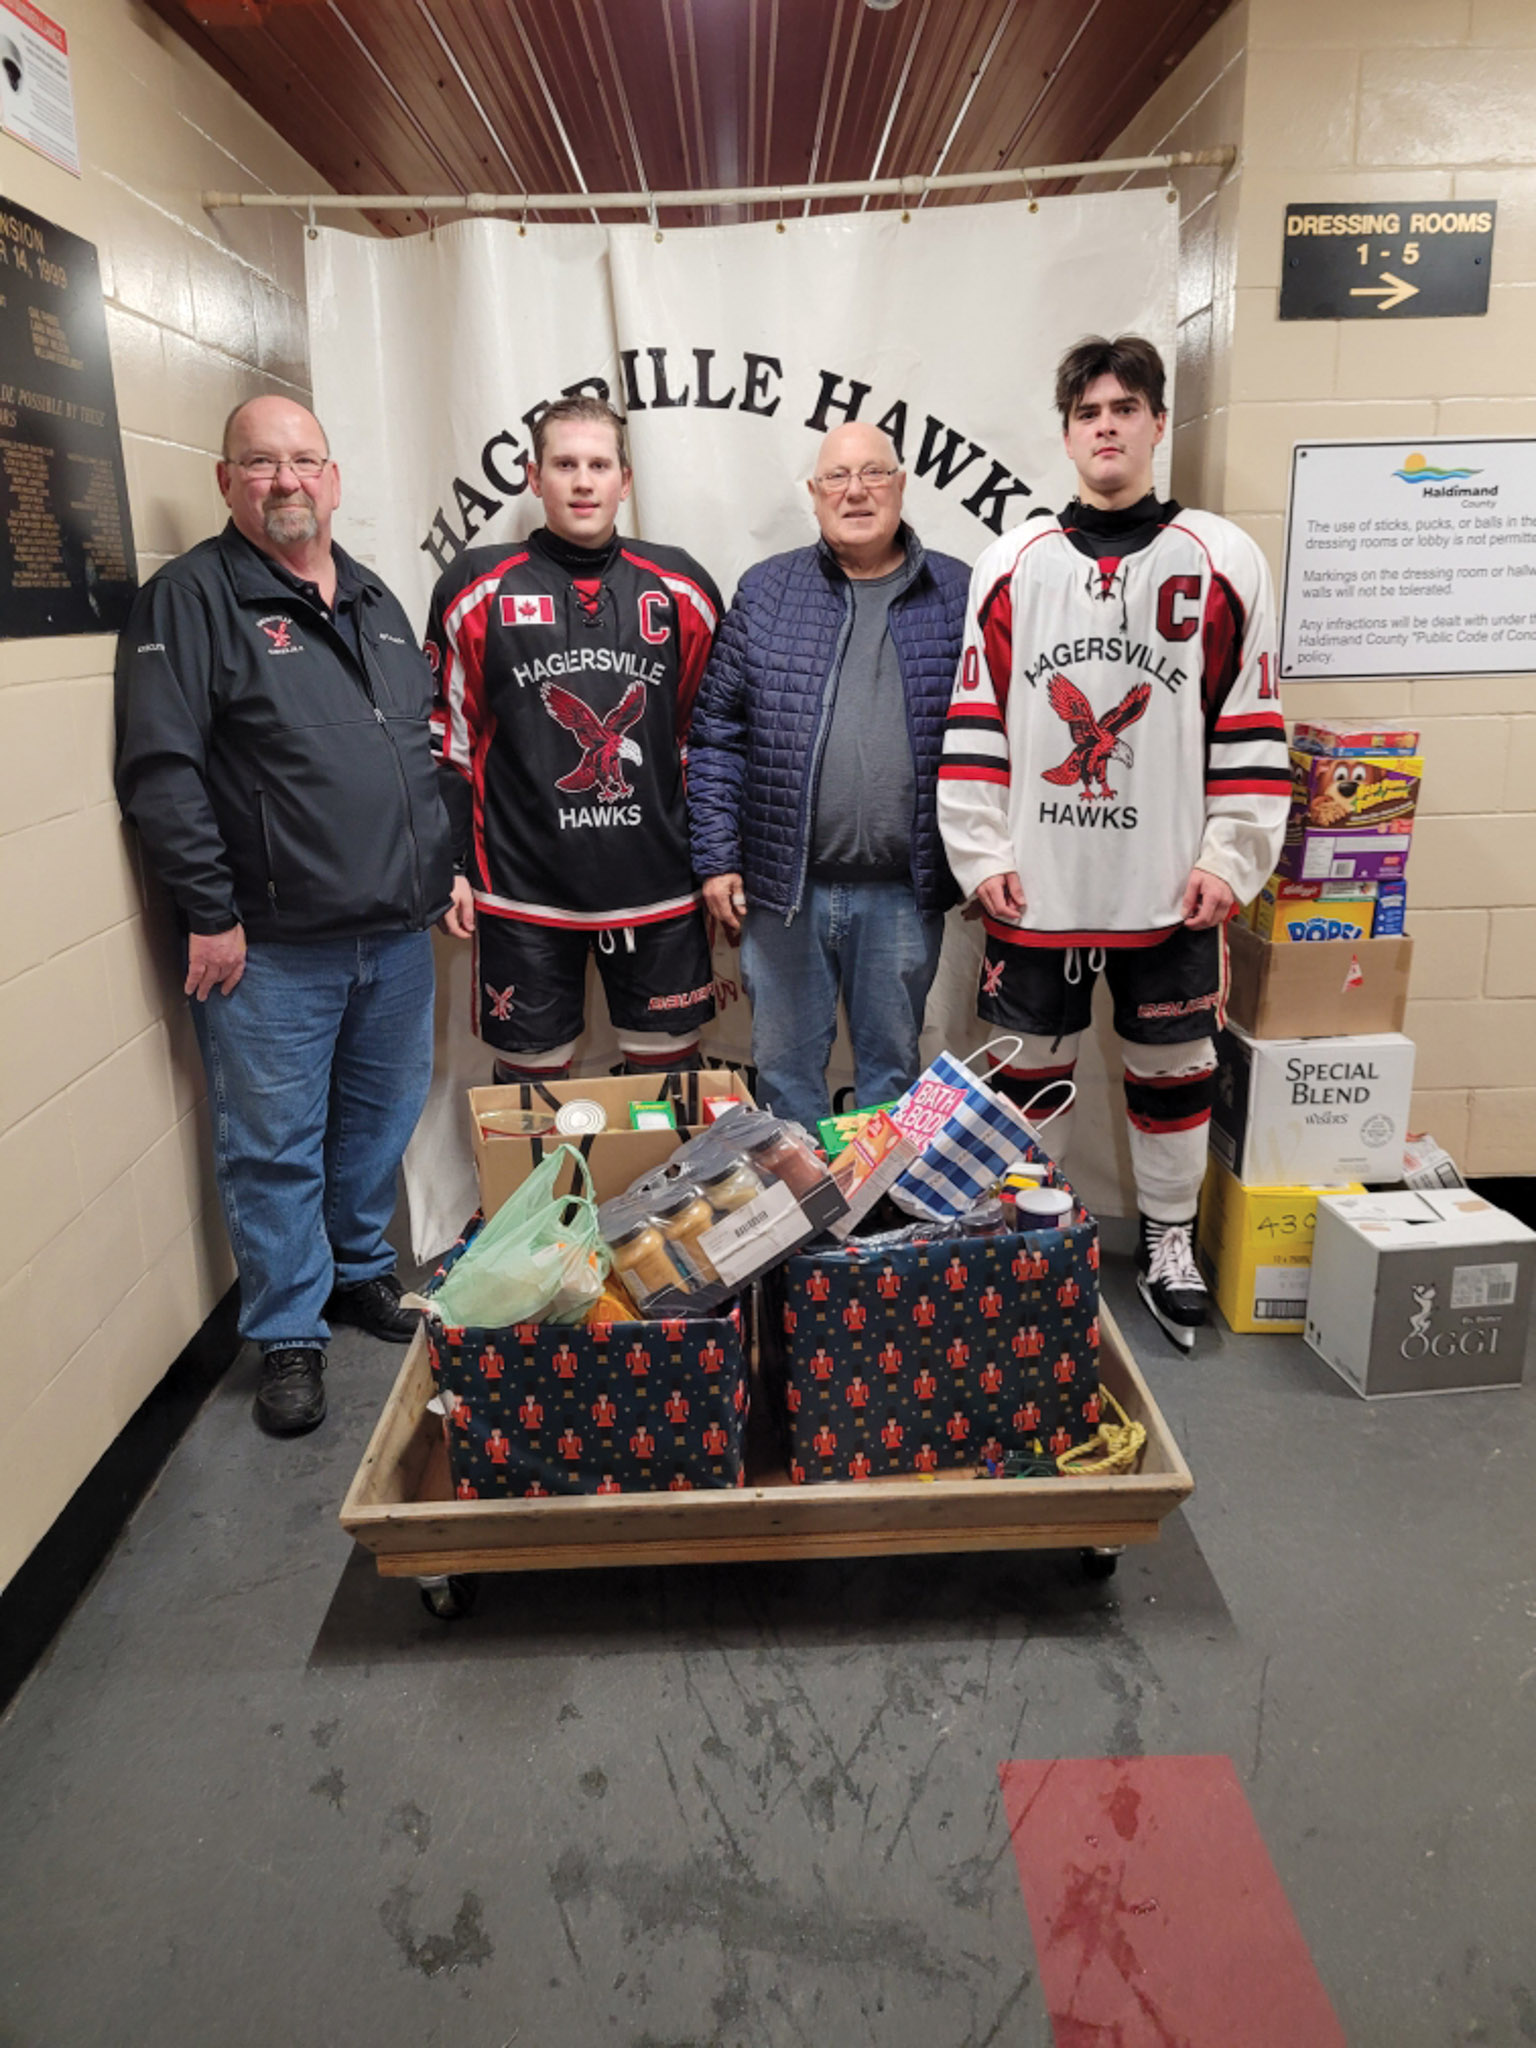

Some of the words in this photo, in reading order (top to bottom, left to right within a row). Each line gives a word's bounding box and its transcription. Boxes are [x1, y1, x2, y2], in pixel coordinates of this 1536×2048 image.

[1287, 213, 1400, 236] DRESSING
[1409, 212, 1492, 234] ROOMS
[1356, 243, 1369, 265] 1
[1402, 242, 1420, 264] 5
[804, 369, 1055, 540] HAWK
[1423, 485, 1498, 498] Haldimand
[1461, 499, 1496, 509] County
[1307, 519, 1330, 533] The
[1334, 521, 1356, 533] use
[1359, 518, 1371, 532] of
[1374, 518, 1411, 532] sticks,
[1416, 519, 1454, 532] pucks,
[1458, 519, 1471, 529] or
[1475, 516, 1502, 529] balls
[1506, 516, 1517, 527] in
[1305, 538, 1357, 551] dressing
[1360, 537, 1398, 548] rooms
[1401, 537, 1414, 547] or
[1418, 533, 1449, 549] lobby
[1453, 534, 1463, 545] is
[1467, 533, 1486, 545] not
[1303, 568, 1358, 583] Markings
[1361, 570, 1376, 581] on
[1380, 568, 1399, 580] the
[1402, 567, 1453, 581] dressing
[1457, 568, 1488, 578] room
[1491, 567, 1503, 577] or
[1302, 587, 1332, 598] walls
[1335, 585, 1355, 597] will
[1358, 586, 1377, 597] not
[1381, 585, 1395, 596] be
[1399, 583, 1454, 596] tolerated.
[639, 591, 669, 644] C
[1156, 575, 1201, 642] C
[1300, 619, 1323, 633] Any
[1326, 617, 1387, 630] infractions
[1391, 616, 1410, 628] will
[1413, 616, 1428, 628] be
[1431, 615, 1461, 627] dealt
[1464, 613, 1488, 626] with
[1491, 613, 1526, 626] under
[1299, 633, 1362, 646] Haldimand
[1365, 632, 1408, 647] County
[1412, 631, 1453, 643] "Public
[1456, 629, 1488, 642] Code
[1491, 629, 1503, 642] of
[512, 648, 666, 688] HAGERSVILLE
[957, 645, 979, 691] 0
[1024, 637, 1188, 694] HAGERSVILLE
[1298, 650, 1335, 664] policy.
[558, 803, 642, 830] HAWKS
[1039, 801, 1138, 829] HAWKS
[1287, 918, 1364, 941] POPS
[1286, 1058, 1379, 1081] SPECIAL
[914, 1082, 958, 1114] BATH
[1291, 1082, 1370, 1105] BLEND
[1257, 1212, 1317, 1239] 430
[1401, 1327, 1498, 1359] OGGI
